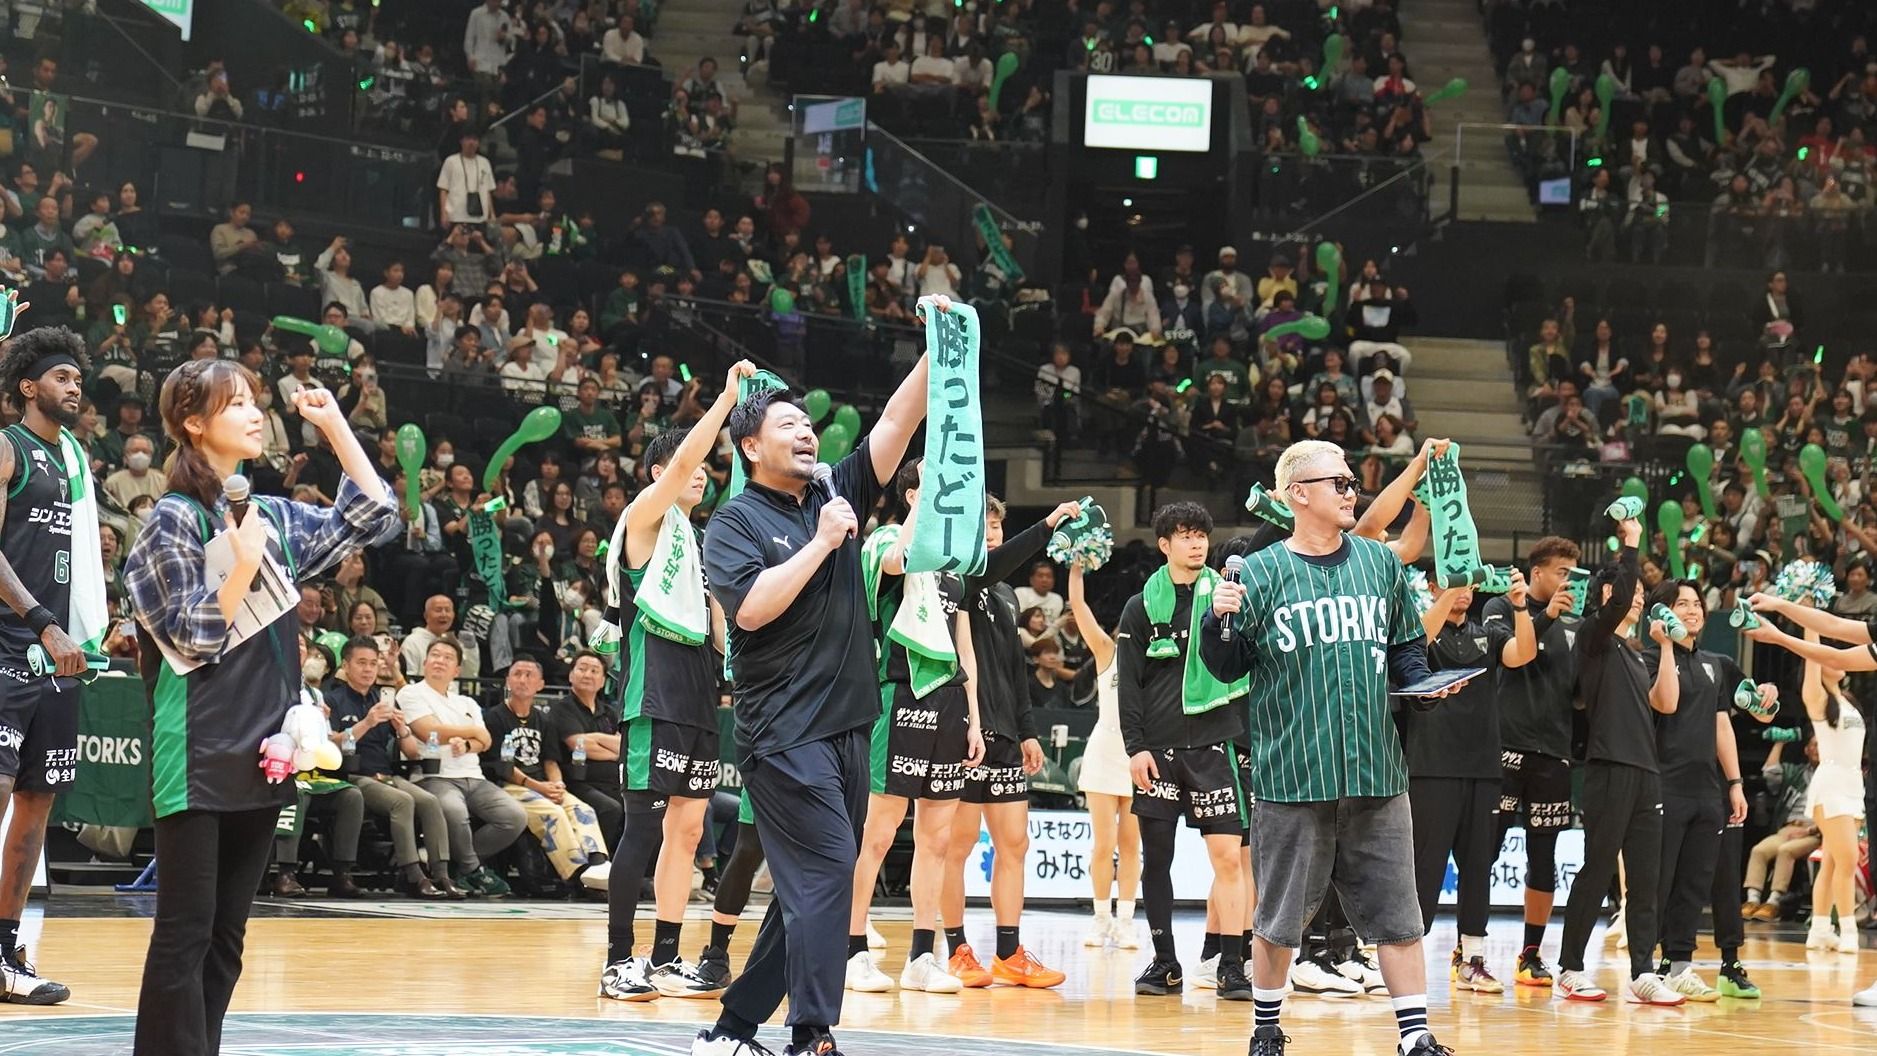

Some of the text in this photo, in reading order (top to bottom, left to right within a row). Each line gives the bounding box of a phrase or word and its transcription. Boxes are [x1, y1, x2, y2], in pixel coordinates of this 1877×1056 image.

[1098, 102, 1200, 123] ELECOM
[54, 549, 70, 584] 6
[1273, 594, 1388, 653] STORKS
